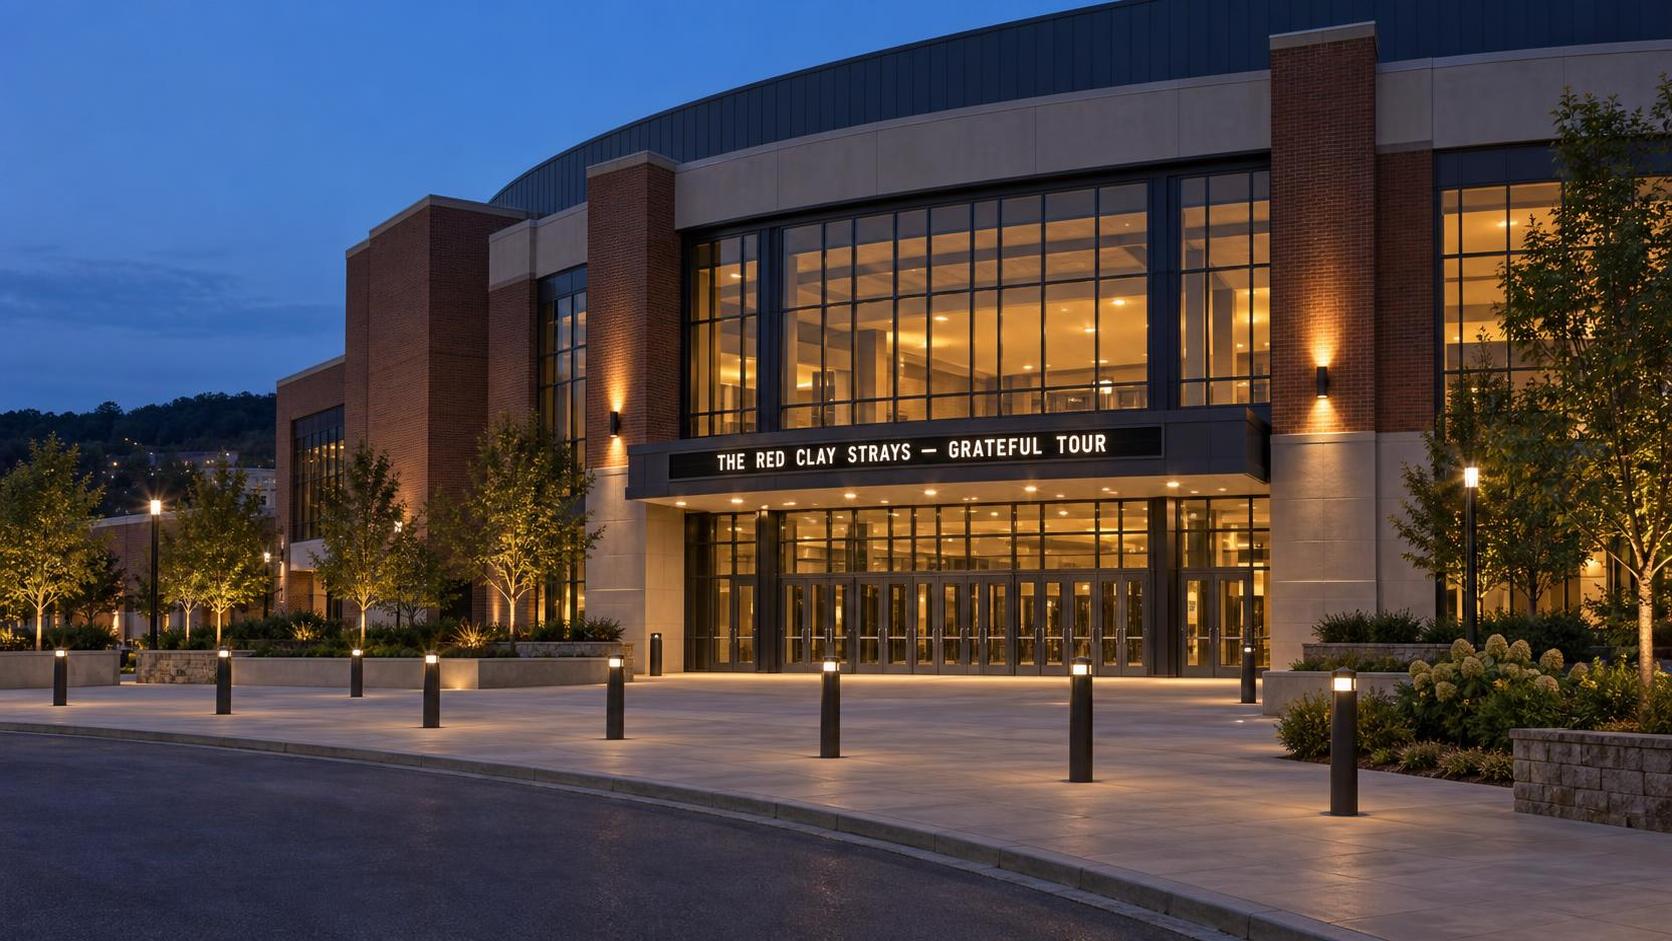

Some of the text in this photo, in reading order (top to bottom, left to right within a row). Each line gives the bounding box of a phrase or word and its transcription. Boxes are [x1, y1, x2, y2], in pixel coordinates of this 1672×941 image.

[716, 452, 745, 471] THE
[756, 451, 785, 469] RED
[797, 447, 836, 467] CLAY
[848, 443, 911, 464] STRAYS
[948, 437, 1042, 459] GRATEFUL
[1055, 434, 1106, 454] TOUR
